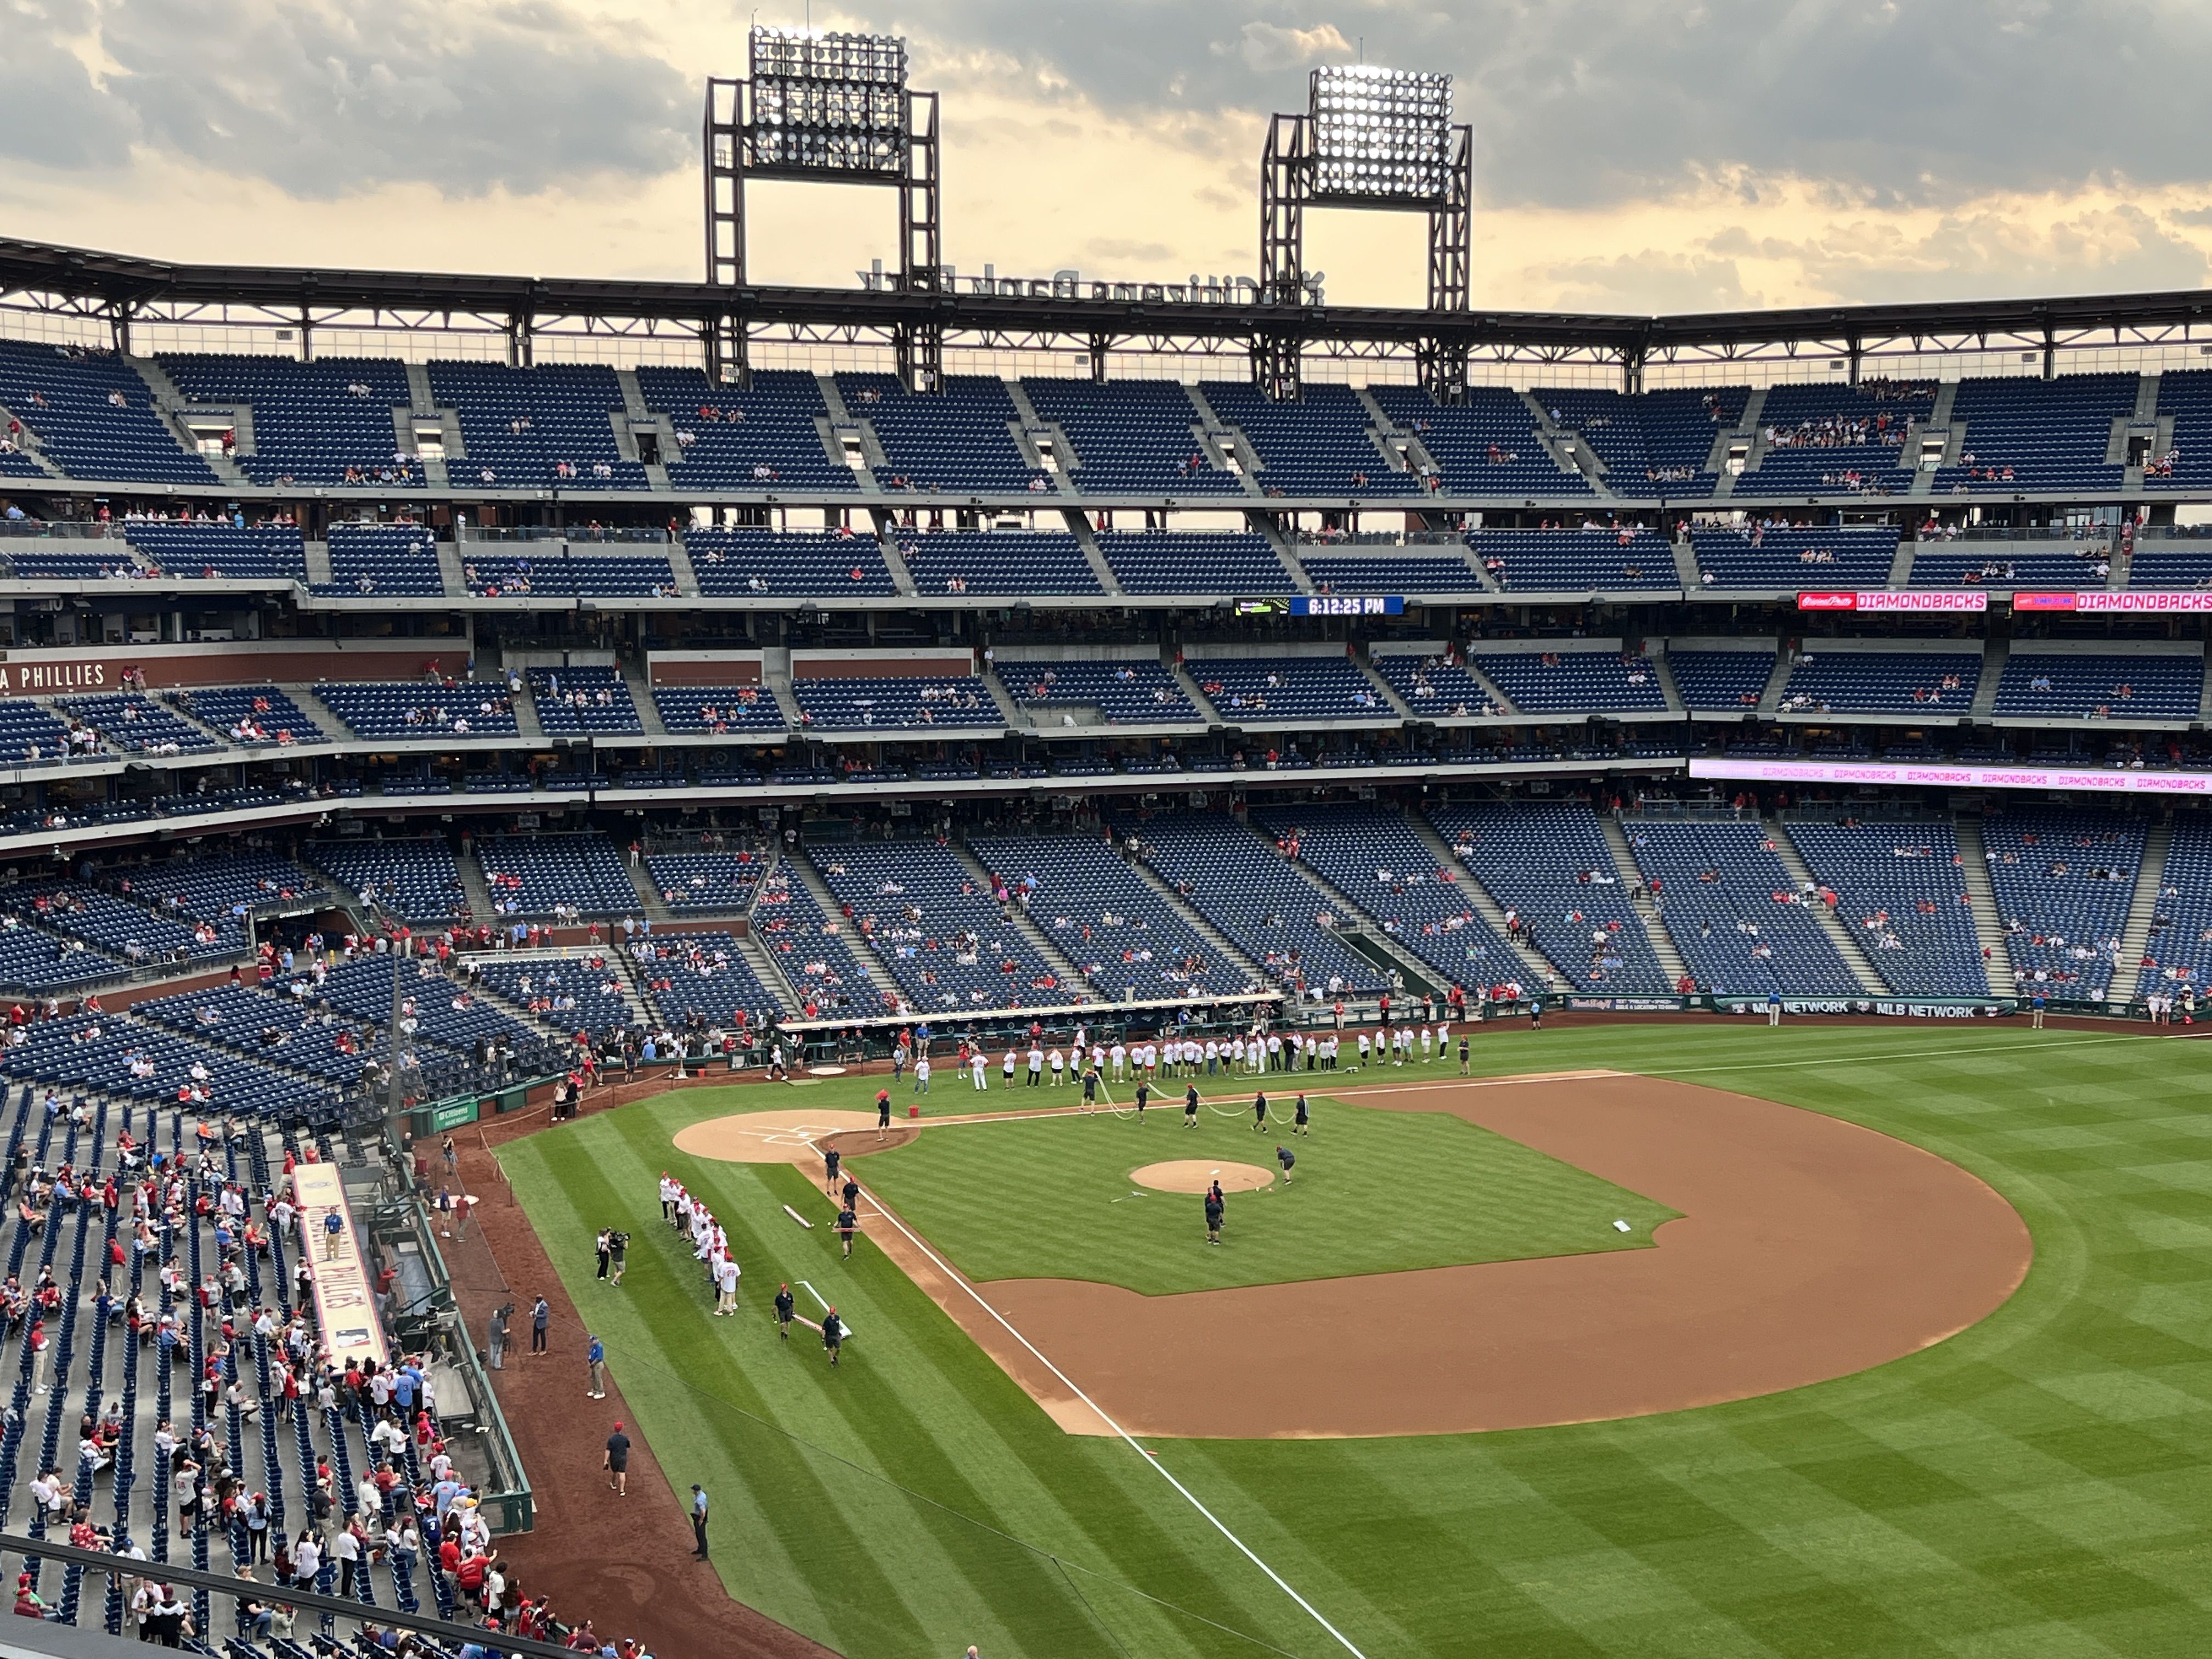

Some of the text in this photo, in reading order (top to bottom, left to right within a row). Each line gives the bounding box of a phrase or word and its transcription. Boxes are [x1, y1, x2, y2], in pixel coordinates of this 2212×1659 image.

[1309, 599, 1385, 614] 6:12:25 PM
[1858, 594, 1985, 608] DIAMONDBACKS
[2077, 595, 2212, 609] DIAMONDBACKS
[21, 664, 104, 689] PHILLIES
[1834, 769, 1897, 780] DIAMONDBACKS
[1907, 771, 1971, 782] DIAMONDBACKS
[1982, 774, 2047, 784] DIAMONDBACKS
[2058, 776, 2125, 787] DIAMONDBACKS
[2136, 778, 2206, 789] DIAMONDBACKS
[1784, 1001, 1849, 1013] NETWORK
[1876, 1003, 1975, 1018] MLB NETWORK
[445, 1107, 468, 1119] Citizens
[319, 1266, 365, 1309] PHILLIES
[430, 1522, 436, 1531] 3
